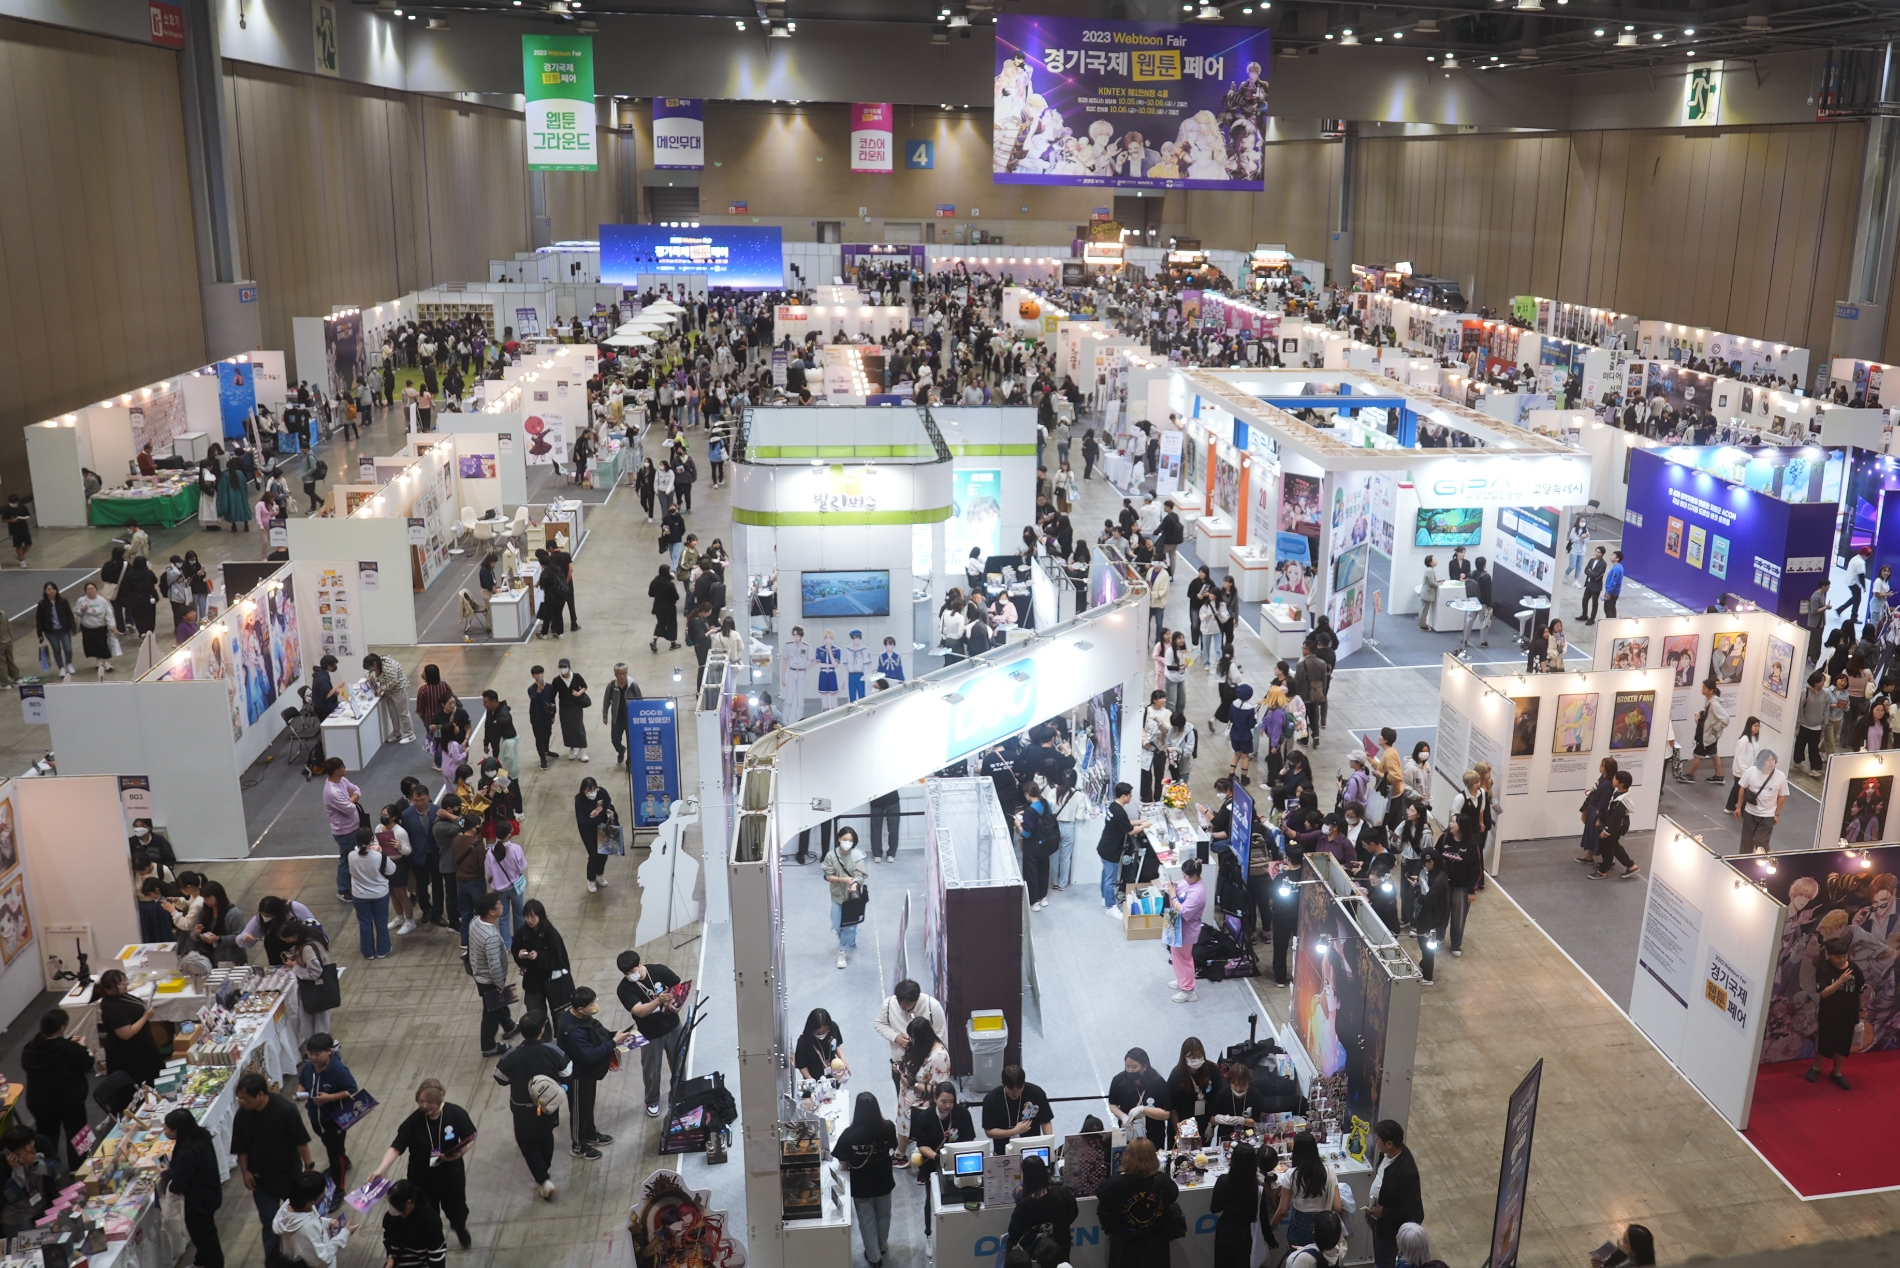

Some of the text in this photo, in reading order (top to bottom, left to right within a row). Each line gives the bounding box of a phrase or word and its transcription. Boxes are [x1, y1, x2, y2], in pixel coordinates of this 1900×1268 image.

[1082, 30, 1187, 47] 2023 Webtoon Fair
[543, 62, 574, 72] 경기국제
[1044, 48, 1224, 80] 경기국제 웹툰 페어
[1098, 87, 1126, 96] KINTEX
[546, 111, 576, 130] 웹툰
[533, 132, 590, 150] 그라운드
[656, 135, 701, 149] 메인무대
[859, 138, 885, 149] 코스어
[859, 150, 885, 162] 라운지
[912, 144, 928, 166] 4
[1433, 474, 1511, 496] GIPA
[1532, 483, 1583, 495] 고양특례시
[1616, 694, 1654, 703] BROKEN FANG
[1711, 962, 1748, 1007] 경기국제
[1708, 981, 1746, 1029] 웹툰 페어
